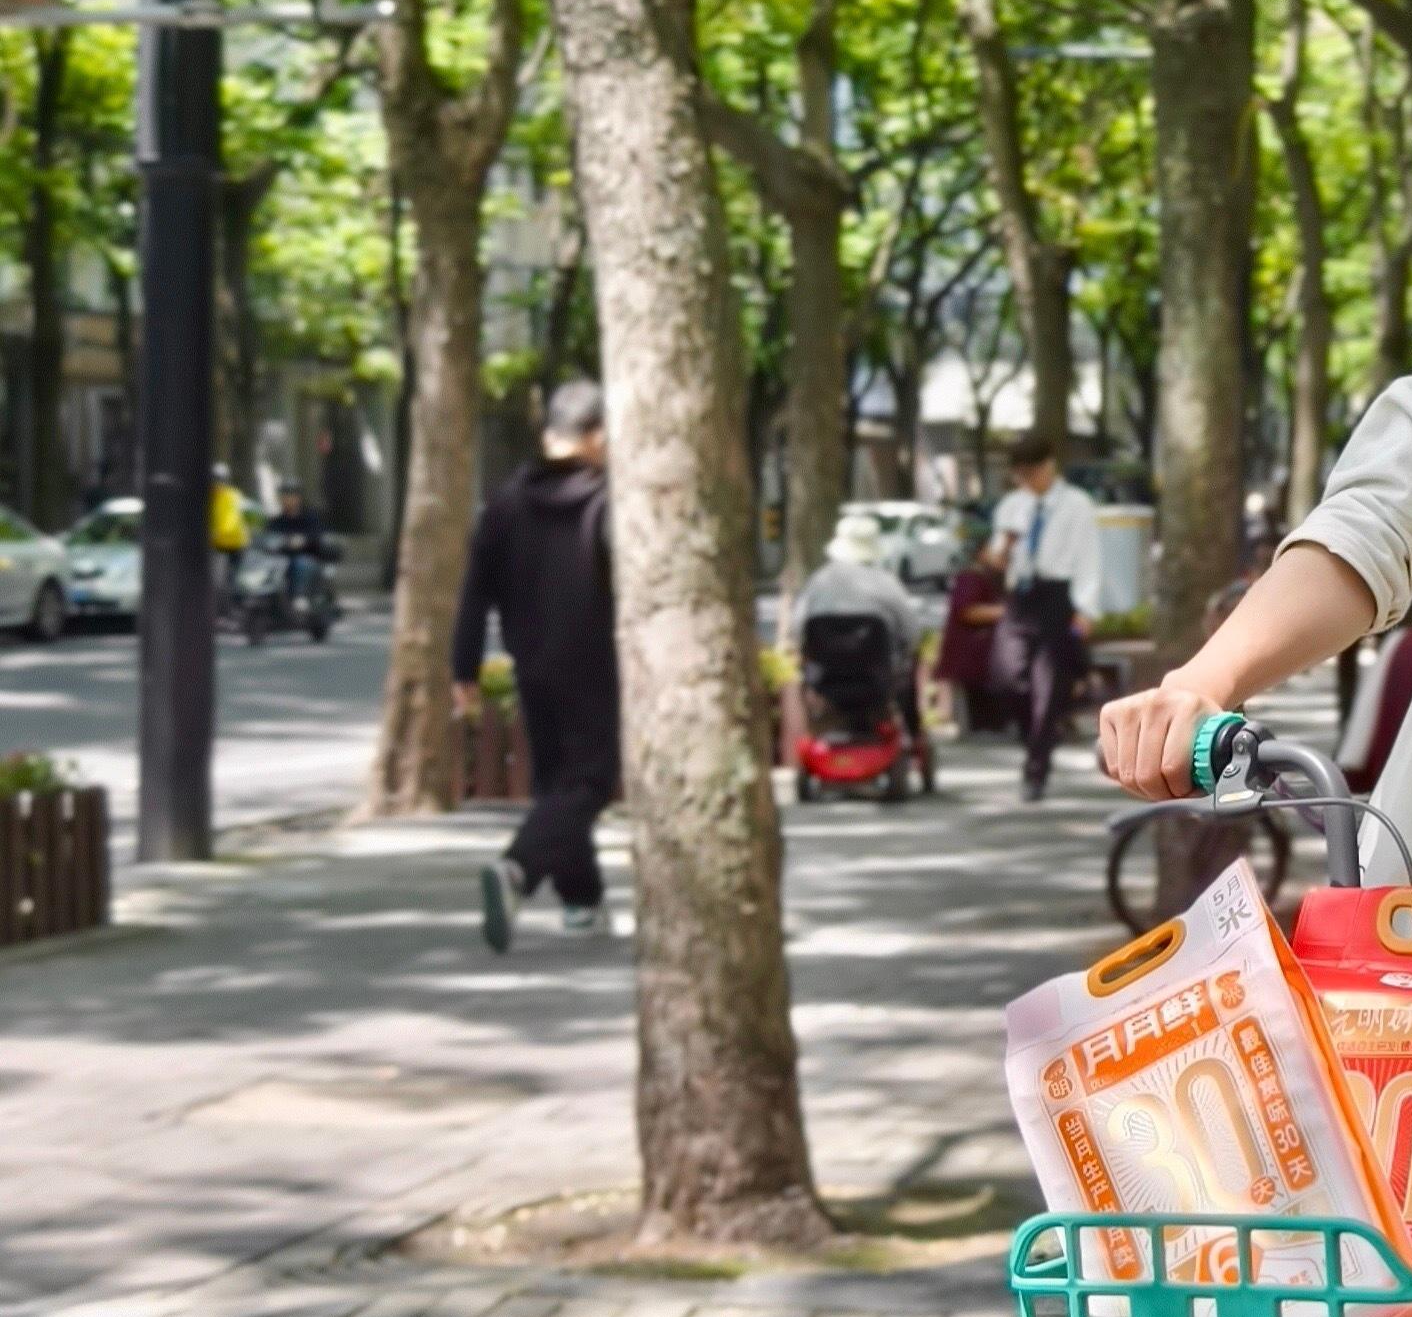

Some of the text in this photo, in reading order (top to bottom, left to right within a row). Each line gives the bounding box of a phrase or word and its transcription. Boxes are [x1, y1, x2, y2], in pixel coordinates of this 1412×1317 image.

[1212, 875, 1241, 907] 5月
[1219, 899, 1252, 938] 米
[1079, 982, 1206, 1078] 月月鲜
